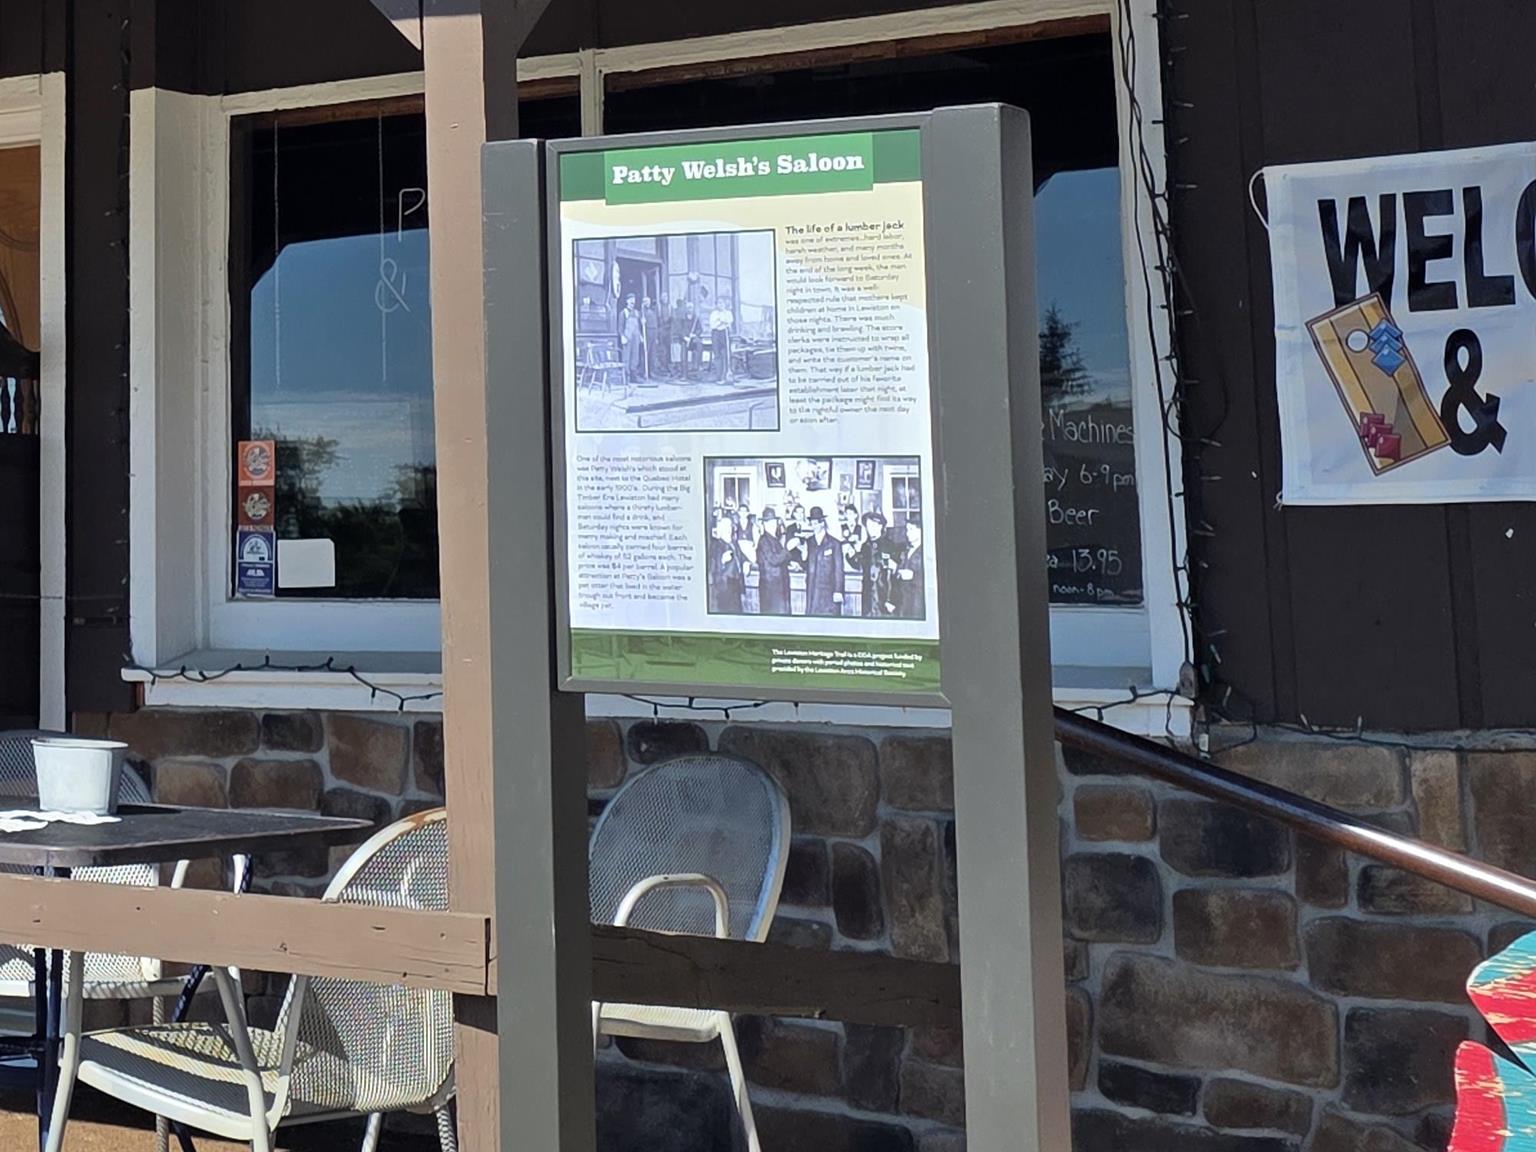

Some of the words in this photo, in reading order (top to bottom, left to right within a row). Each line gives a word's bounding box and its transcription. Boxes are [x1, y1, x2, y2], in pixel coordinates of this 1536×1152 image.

[612, 166, 675, 186] Patty
[681, 156, 770, 180] Welsh's
[777, 153, 864, 174] Saloon
[786, 226, 803, 234] The
[807, 224, 821, 232] life
[824, 223, 835, 232] of
[846, 222, 880, 232] lumber
[882, 220, 904, 232] jack
[1440, 328, 1507, 456] &
[1048, 408, 1134, 445] Machines
[1047, 499, 1100, 525] Beer
[1072, 549, 1122, 576] 13.95
